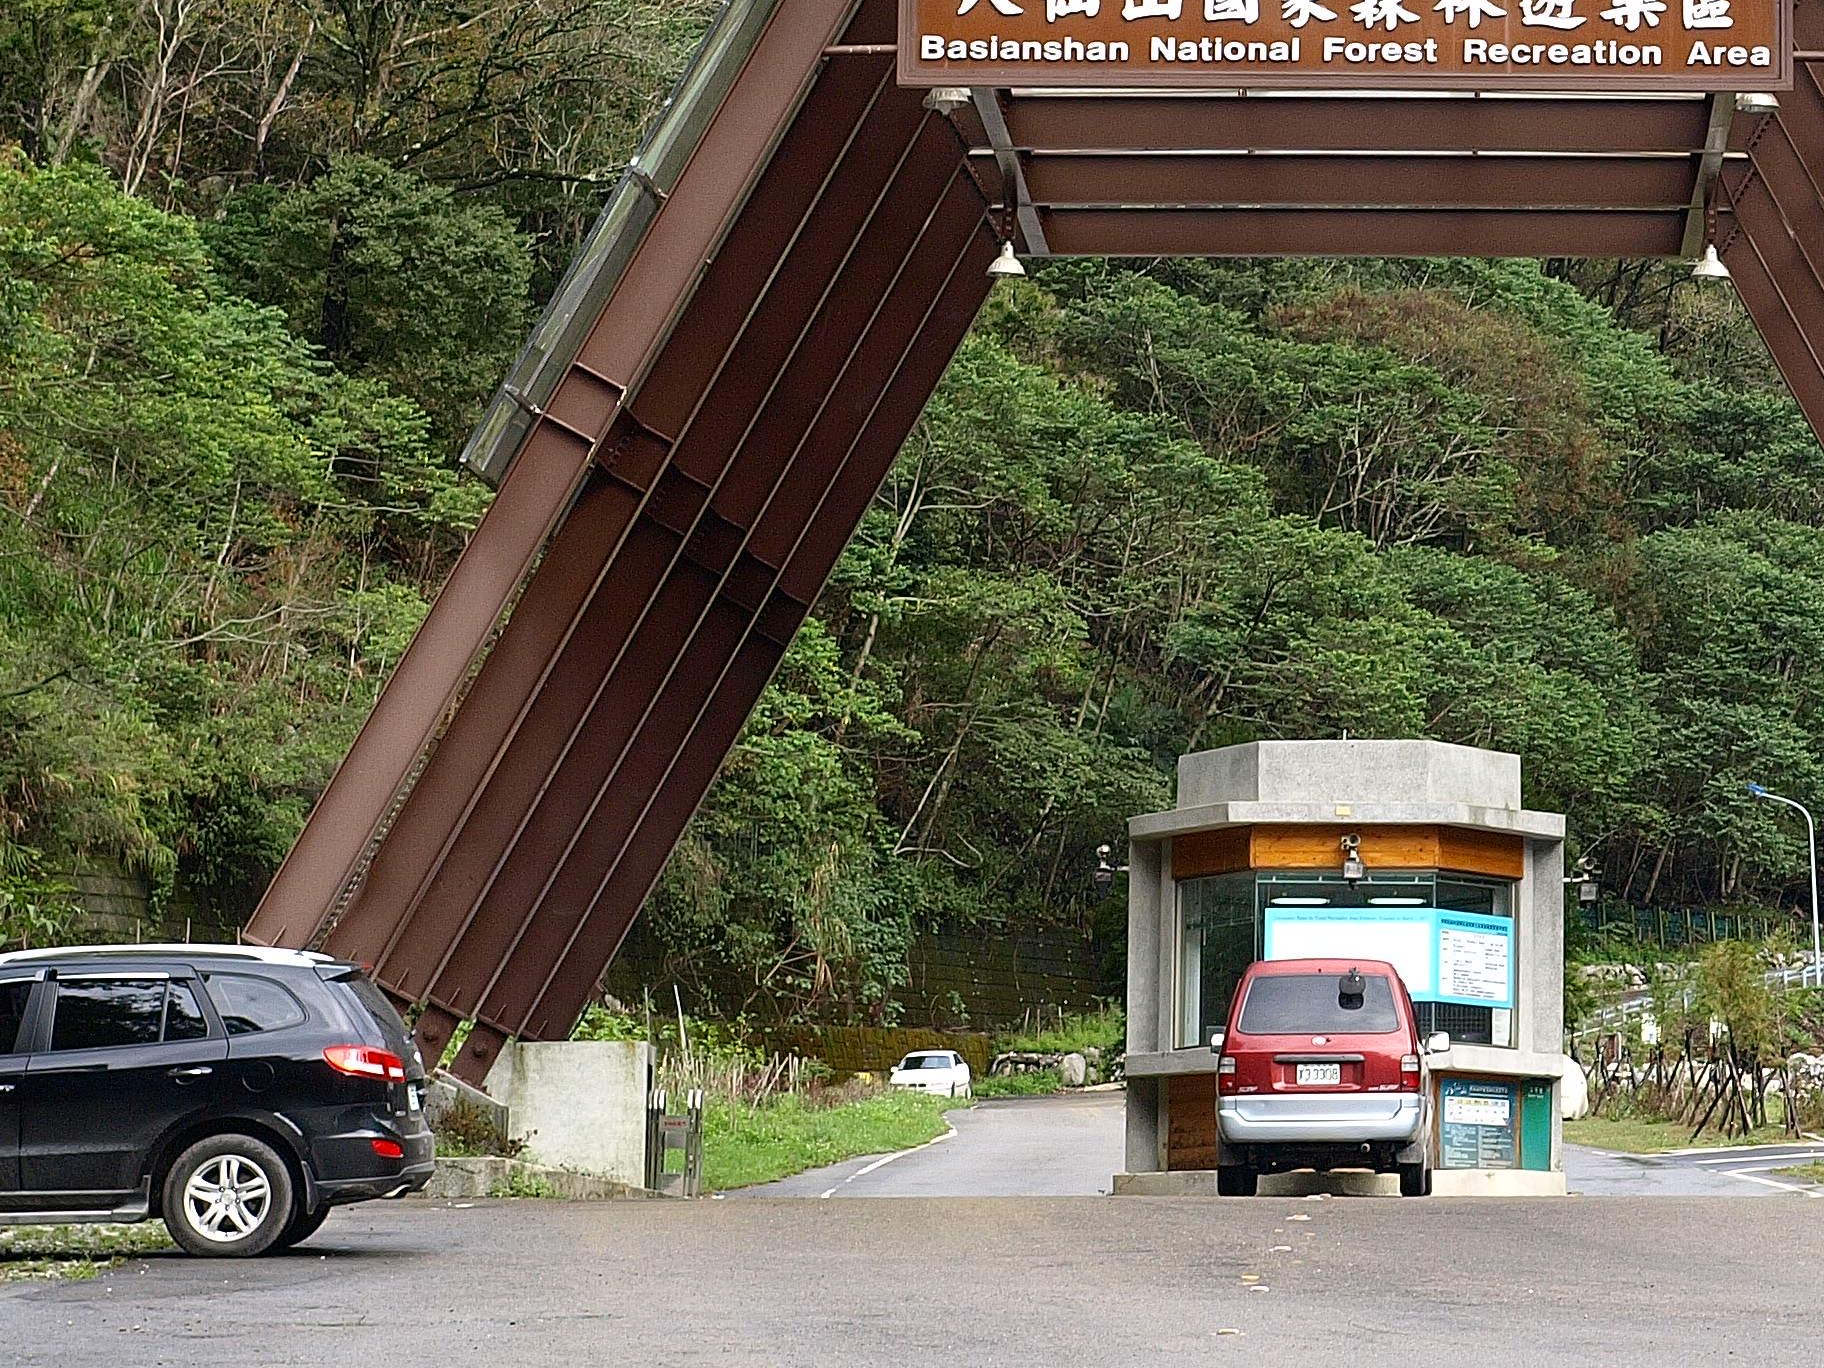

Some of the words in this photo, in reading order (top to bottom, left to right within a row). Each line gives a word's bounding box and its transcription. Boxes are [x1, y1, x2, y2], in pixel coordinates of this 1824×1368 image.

[920, 35, 1130, 62] Basianshan
[1149, 36, 1301, 62] National
[1323, 37, 1439, 64] Forest
[1463, 39, 1663, 65] Recreation
[1687, 41, 1772, 66] Area
